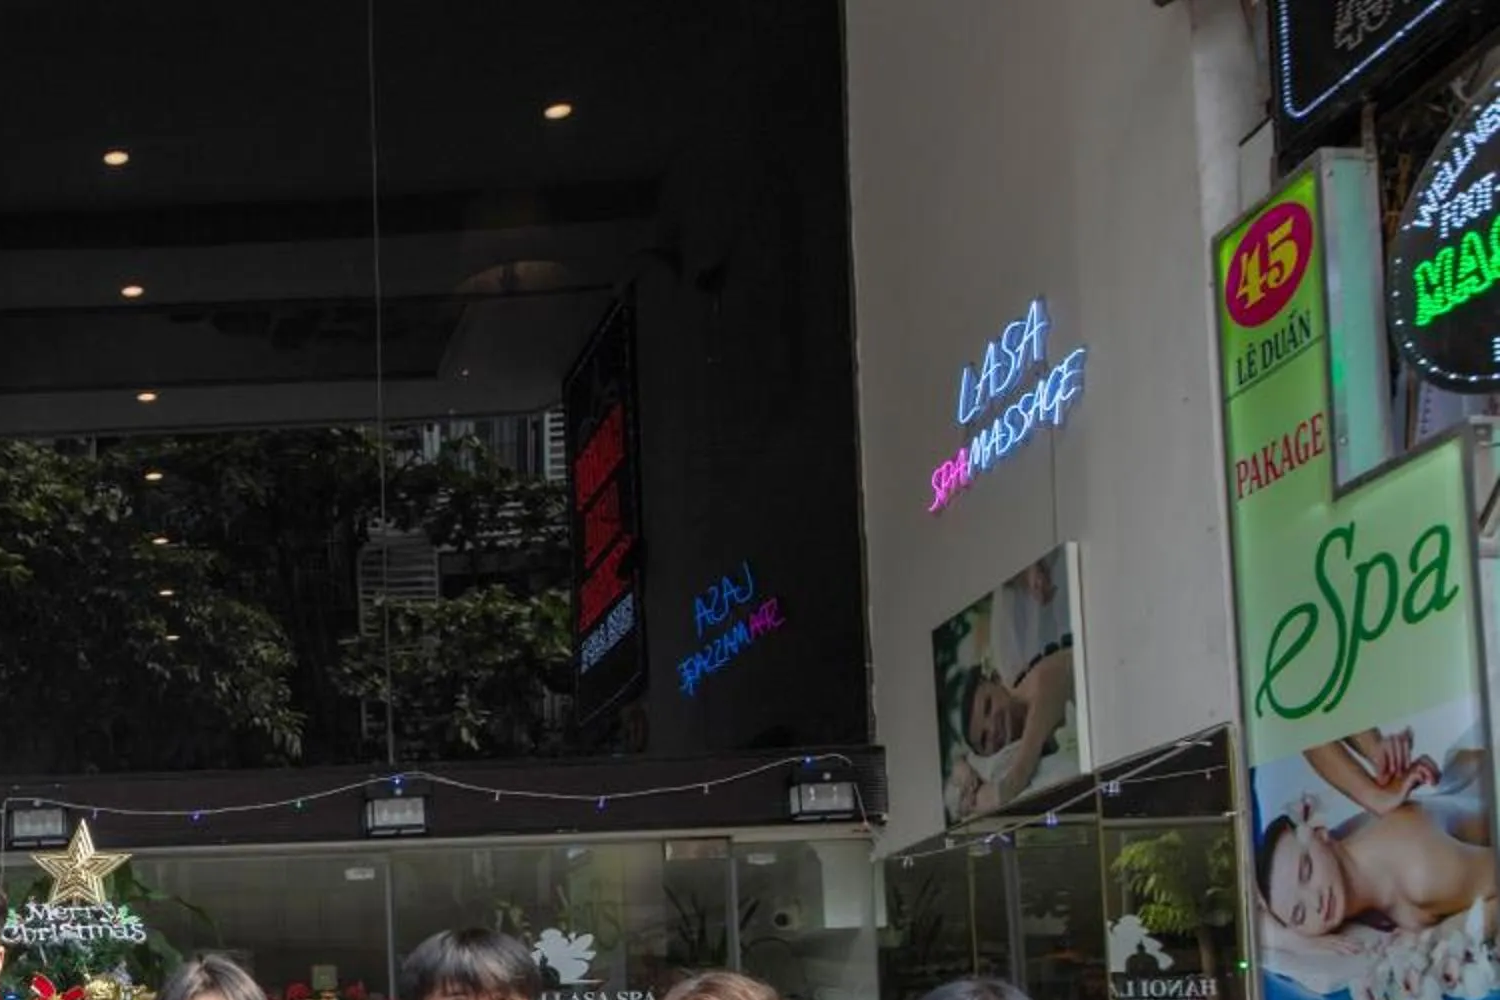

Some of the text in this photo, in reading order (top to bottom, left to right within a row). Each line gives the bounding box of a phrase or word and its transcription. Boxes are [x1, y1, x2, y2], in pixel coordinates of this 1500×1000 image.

[1236, 216, 1298, 309] 45
[959, 300, 1051, 424] LASA
[1236, 412, 1325, 500] PAKAGE
[1, 922, 147, 944] Christmas
[25, 899, 117, 923] Merry
